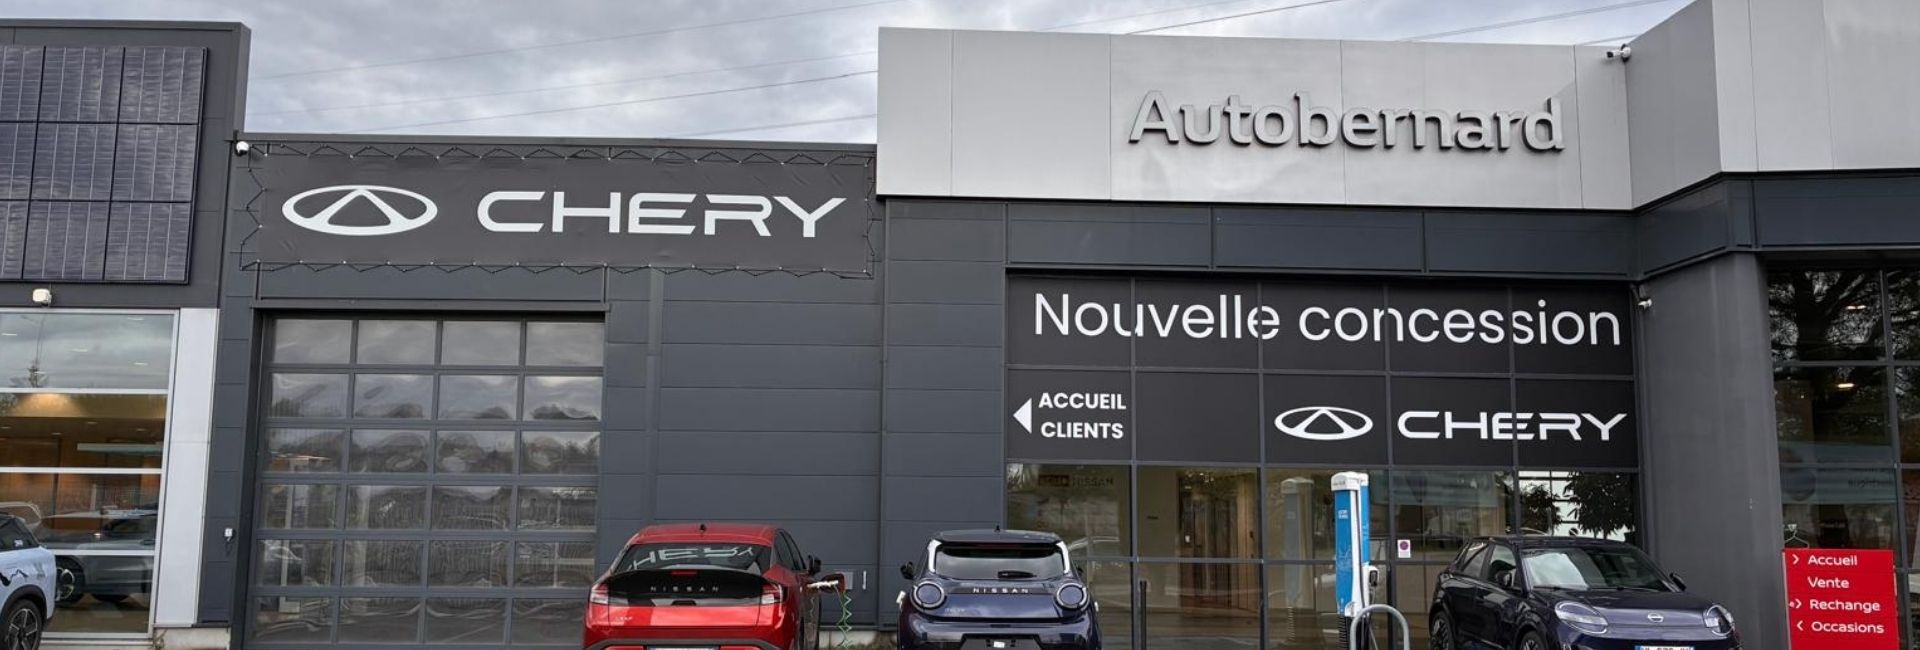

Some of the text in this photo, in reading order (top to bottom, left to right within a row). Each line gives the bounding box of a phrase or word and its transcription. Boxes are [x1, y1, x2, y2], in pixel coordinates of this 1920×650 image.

[1128, 90, 1565, 152] Autobernard
[477, 190, 847, 238] CHERY
[1034, 293, 1622, 346] Nouvelle concession
[1038, 392, 1127, 411] ACCUEIL
[1040, 421, 1124, 440] CLIENTS
[1397, 411, 1628, 441] CHERY
[1807, 555, 1858, 566] Accueil
[1807, 576, 1850, 589] Vente
[1809, 599, 1881, 614] Rechange
[1811, 621, 1885, 634] Occasions
